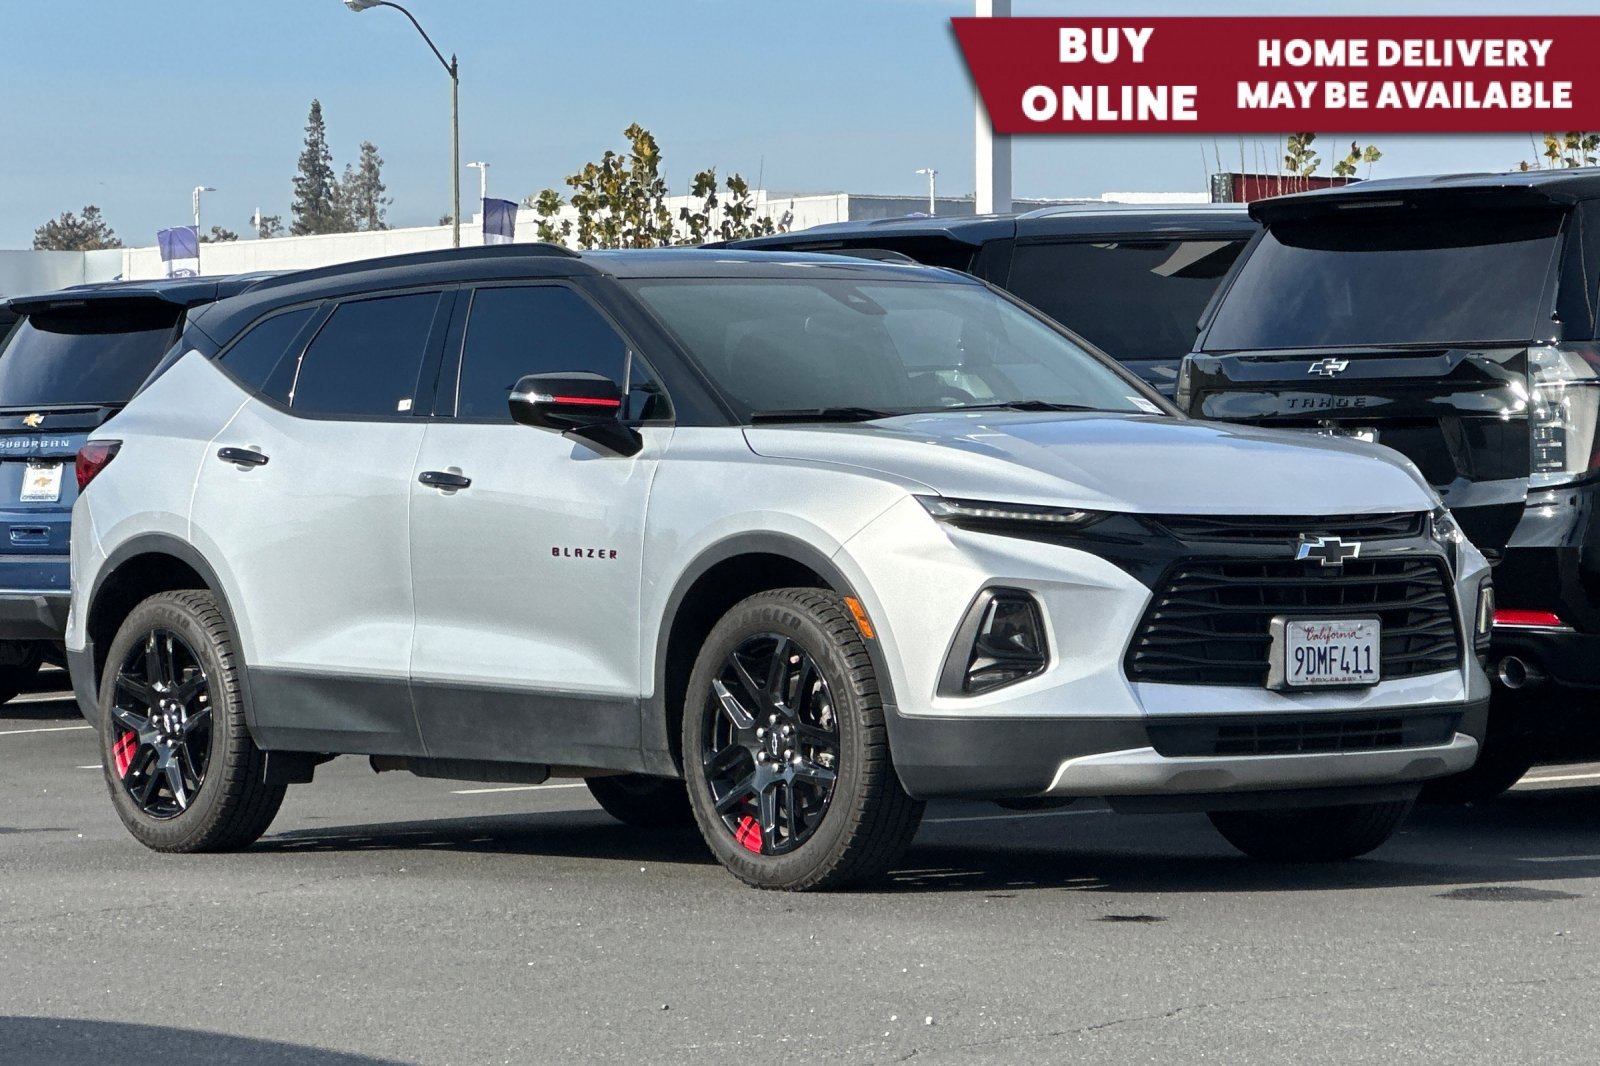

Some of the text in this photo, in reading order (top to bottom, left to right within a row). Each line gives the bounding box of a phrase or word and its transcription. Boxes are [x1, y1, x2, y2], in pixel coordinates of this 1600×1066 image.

[1287, 397, 1367, 408] TAHOE
[0, 439, 70, 449] SUBURBAN
[552, 547, 617, 560] BLAZER
[1305, 626, 1362, 644] California
[1294, 645, 1374, 676] 9DMF411
